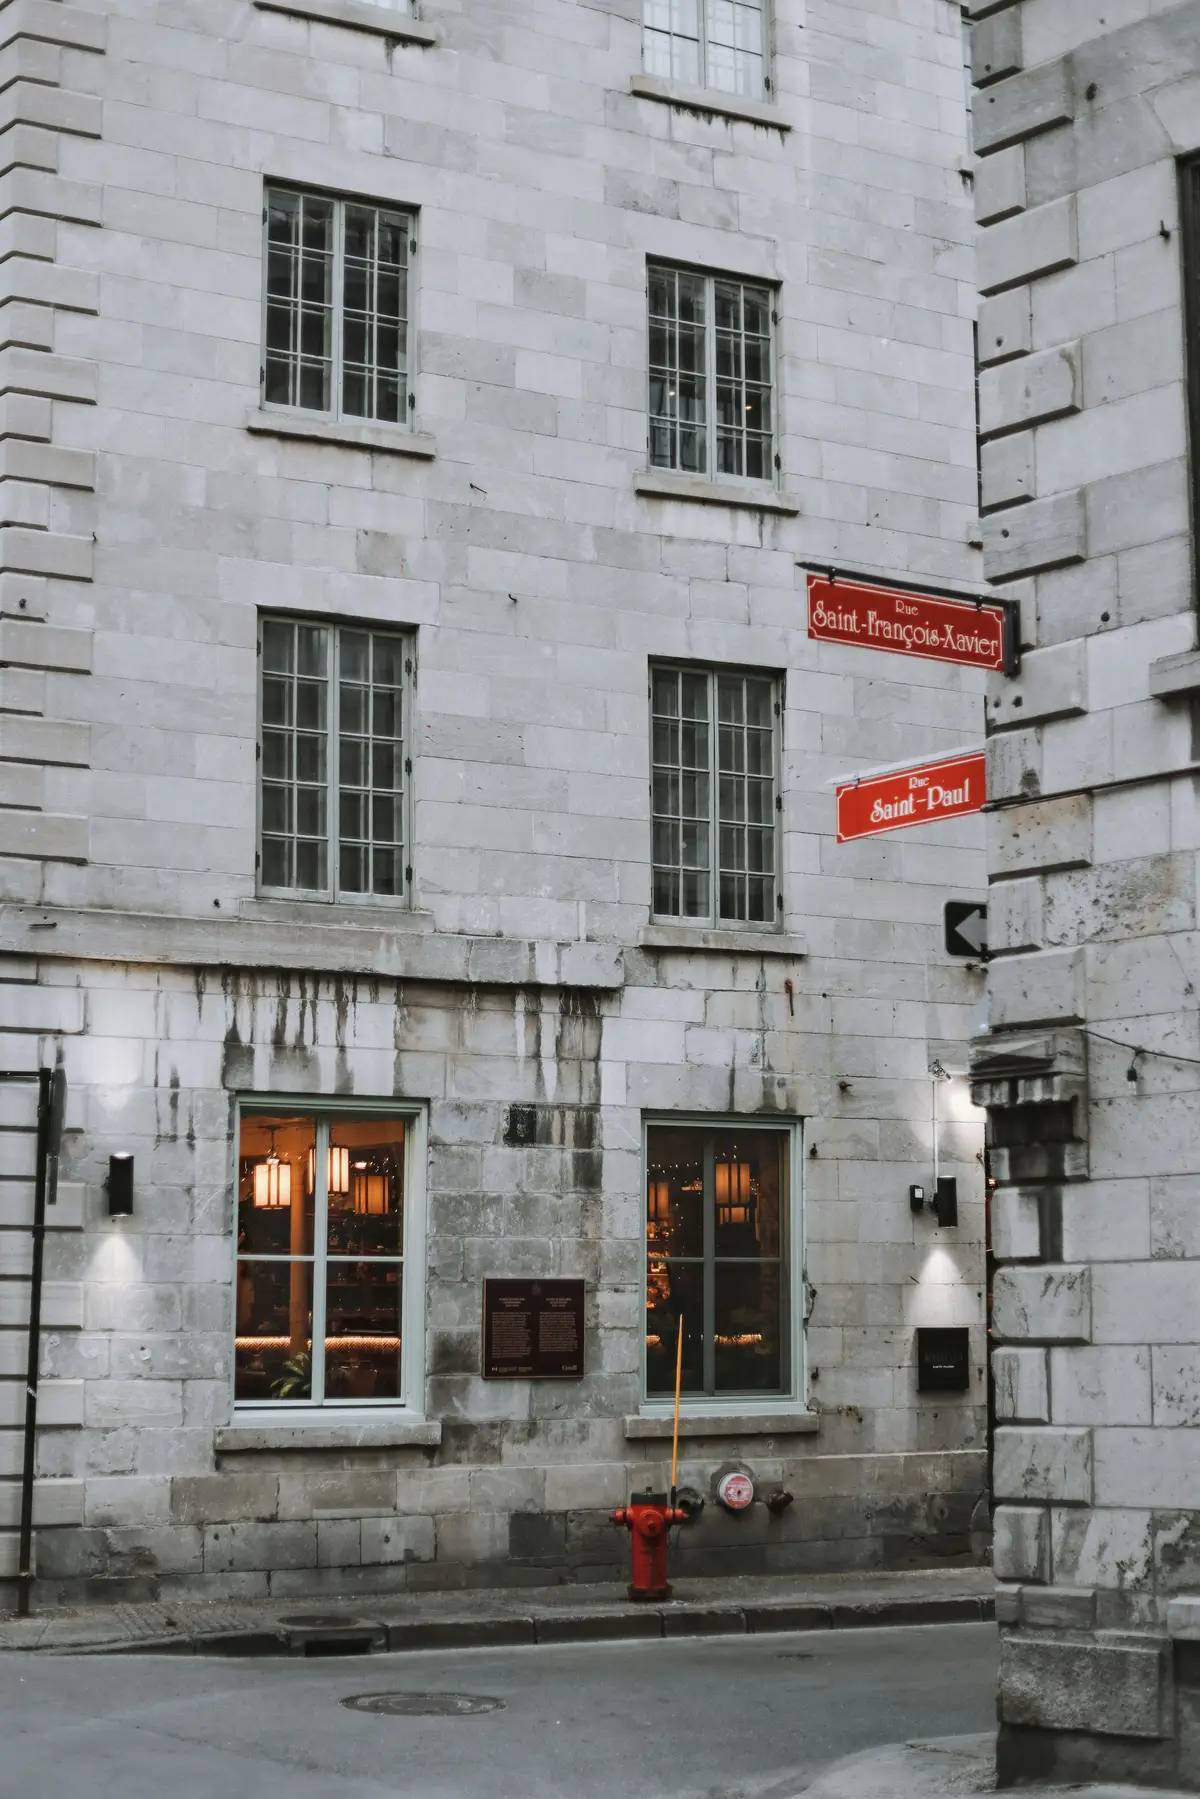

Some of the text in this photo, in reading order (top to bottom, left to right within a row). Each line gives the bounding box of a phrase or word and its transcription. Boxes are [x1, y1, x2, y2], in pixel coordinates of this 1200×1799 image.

[895, 599, 919, 616] Rue
[812, 600, 999, 656] Saint-François-Xavier
[908, 776, 930, 790] Rue
